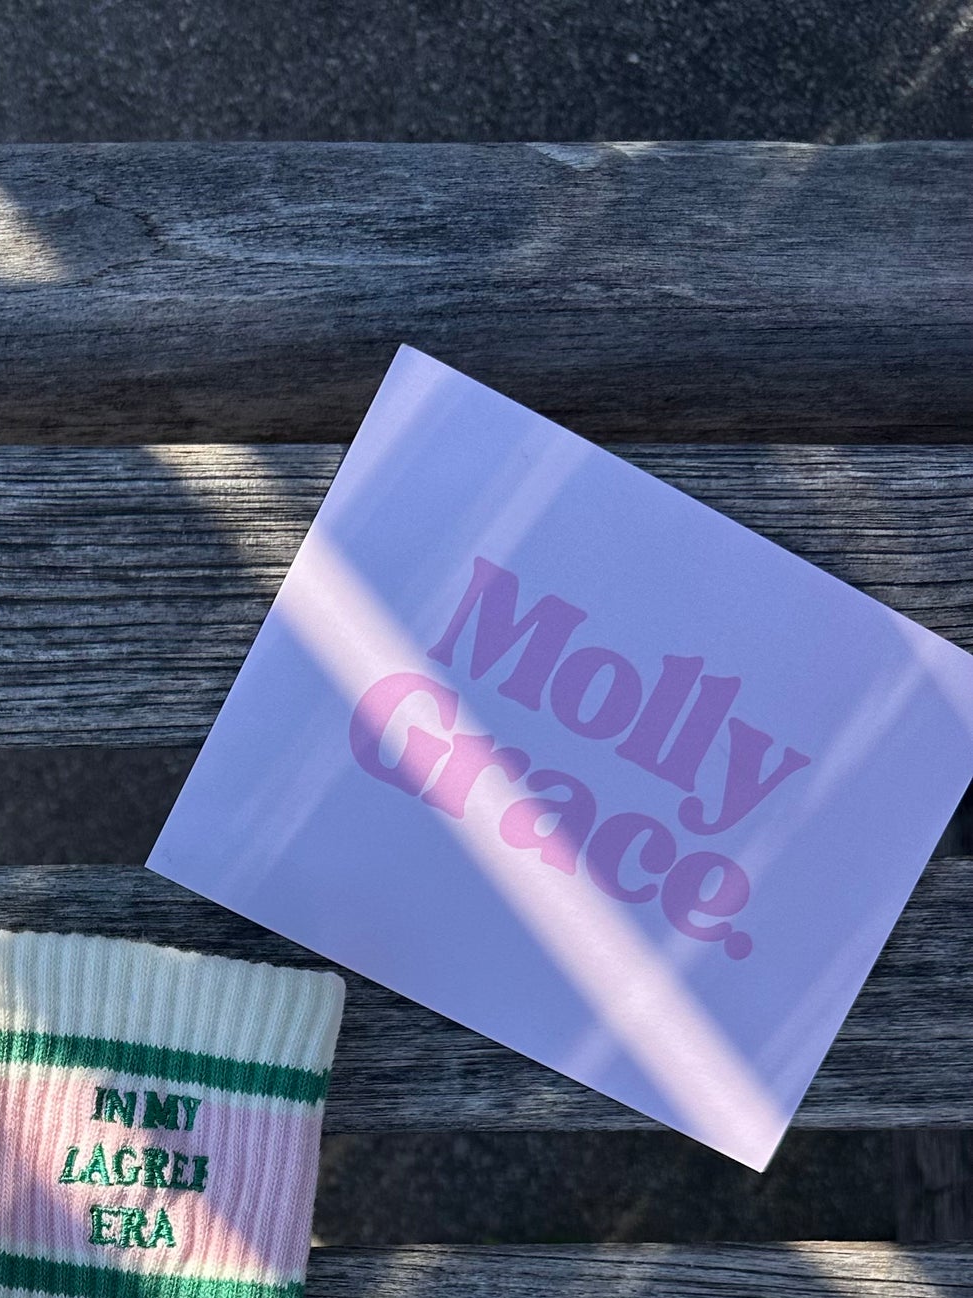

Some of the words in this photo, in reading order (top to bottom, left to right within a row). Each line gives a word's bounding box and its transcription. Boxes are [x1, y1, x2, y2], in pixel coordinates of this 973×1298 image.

[427, 555, 812, 836] Molly
[348, 671, 753, 961] Grace.
[90, 1086, 137, 1129] IN
[141, 1090, 203, 1131] MY
[88, 1204, 177, 1249] ERA
